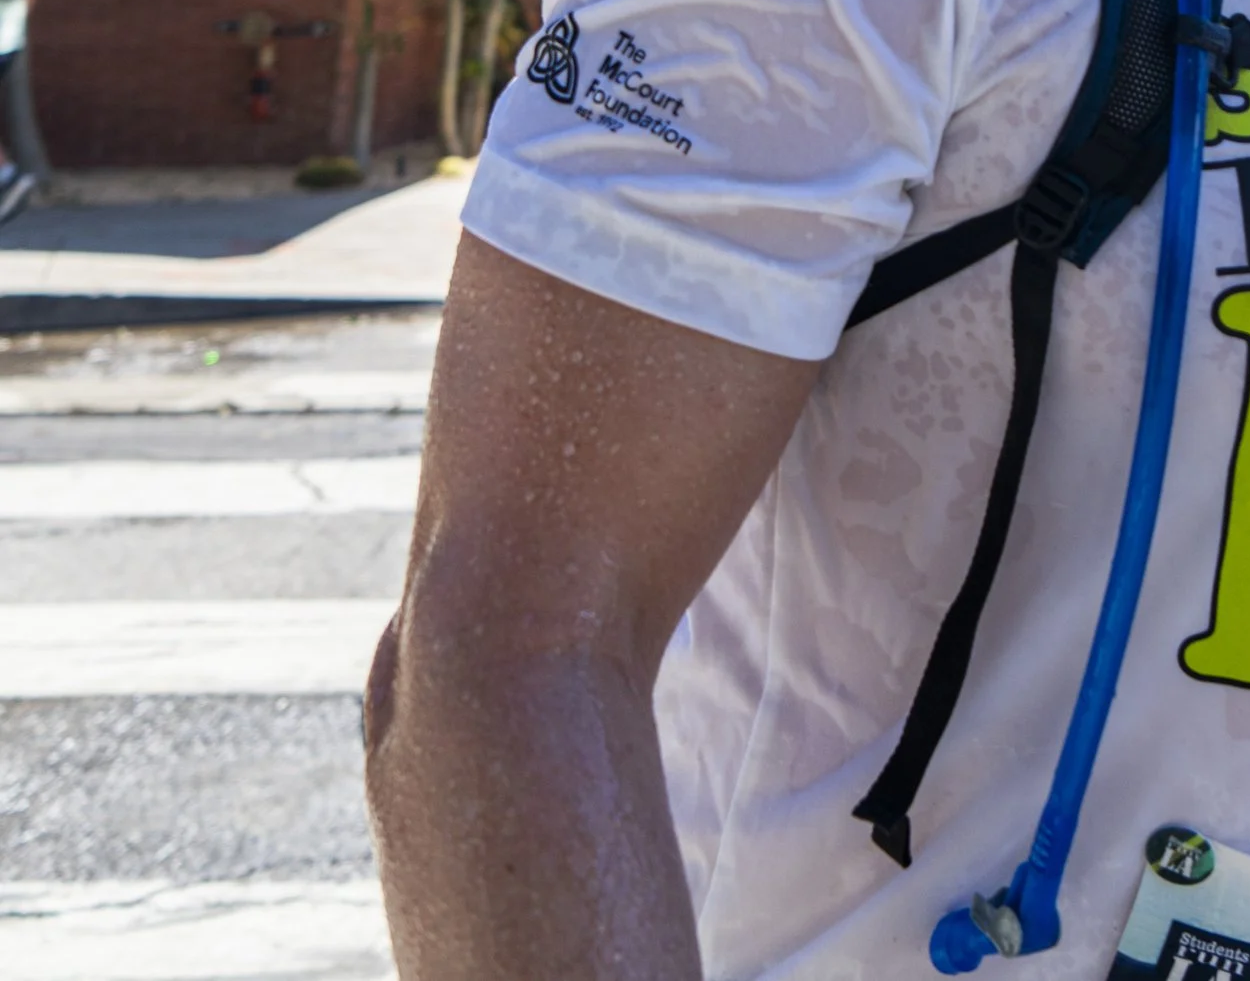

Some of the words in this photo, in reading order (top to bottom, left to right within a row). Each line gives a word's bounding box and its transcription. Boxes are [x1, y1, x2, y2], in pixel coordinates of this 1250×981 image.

[612, 30, 646, 64] The
[598, 54, 684, 117] McCourt
[584, 79, 693, 156] Foundation
[1179, 930, 1250, 963] Students
